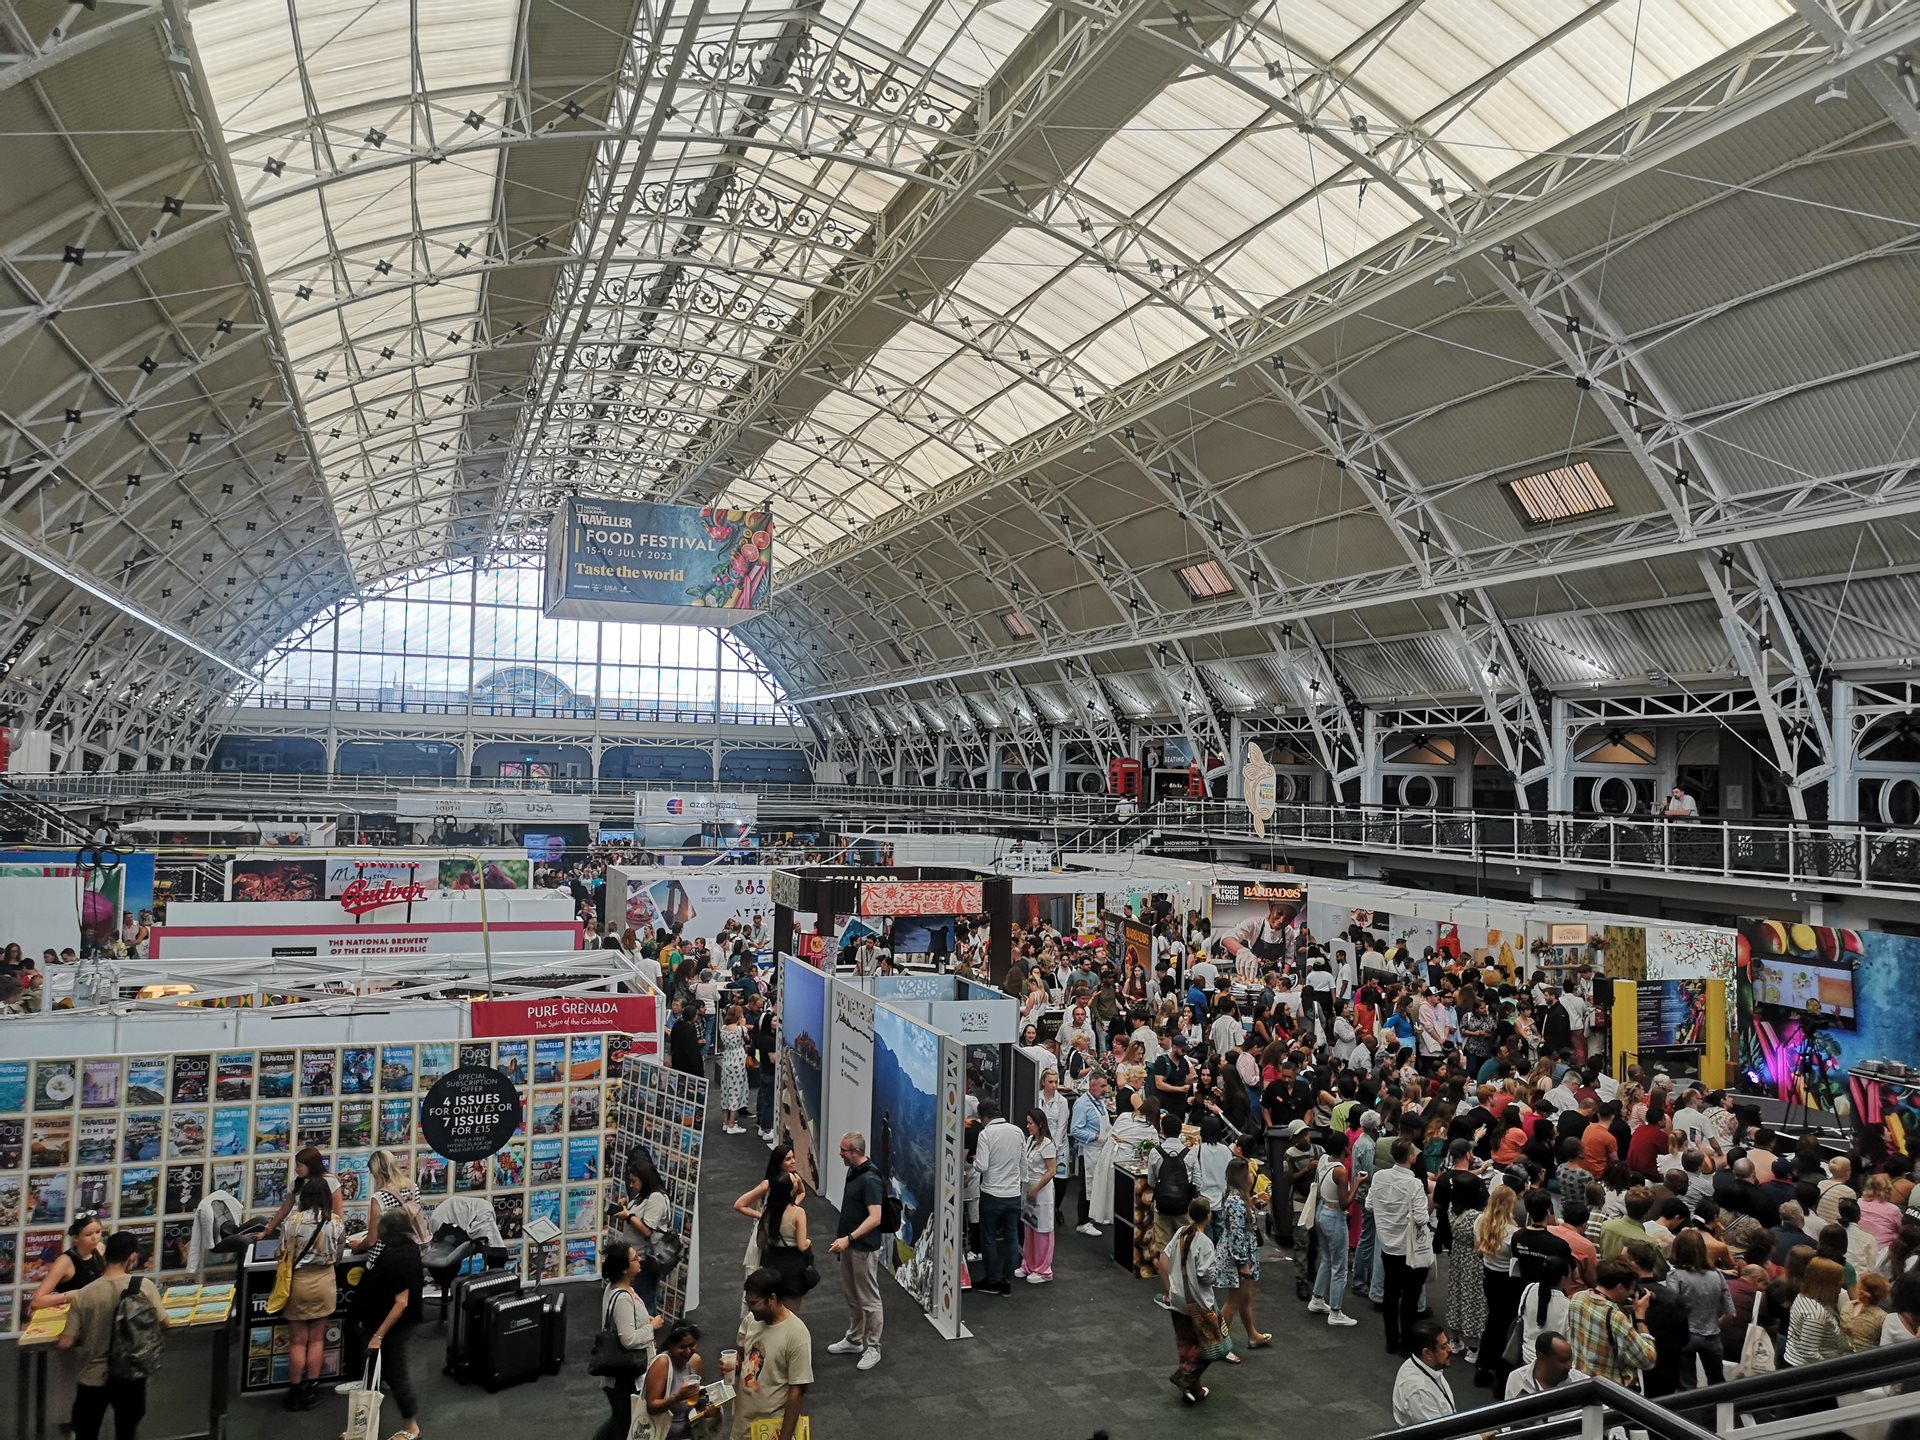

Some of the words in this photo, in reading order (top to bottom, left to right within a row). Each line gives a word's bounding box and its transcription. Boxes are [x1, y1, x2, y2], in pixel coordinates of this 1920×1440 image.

[576, 514, 632, 528] TRAVELLER
[586, 530, 634, 546] FOOD
[640, 534, 716, 552] FESTIVAL
[586, 546, 614, 556] 15-16
[617, 549, 644, 558] JULY
[648, 551, 673, 560] 2023
[574, 562, 614, 578] Taste
[617, 565, 640, 580] the
[642, 569, 684, 582] world
[526, 803, 554, 812] USA
[896, 979, 938, 990] MONTE
[528, 1004, 558, 1018] PURE
[562, 1002, 618, 1014] GRENADA
[548, 1020, 563, 1028] Spice
[581, 1017, 613, 1026] Caribbean
[460, 1049, 490, 1058] FOOD
[174, 1061, 209, 1072] FOOD
[446, 1079, 498, 1088] SUBSCRIPTION
[443, 1097, 451, 1106] 4
[456, 1094, 500, 1105] ISSUES
[430, 1108, 449, 1116] FOR
[453, 1106, 480, 1115] ONLY
[484, 1104, 495, 1112] £3
[498, 1103, 512, 1111] OR
[443, 1118, 450, 1127] 7
[455, 1114, 499, 1126] ISSUES
[452, 1127, 471, 1135] FOR
[475, 1125, 490, 1133] £15
[494, 1200, 522, 1209] FOOD
[165, 1227, 192, 1237] FOO
[567, 1241, 595, 1250] TRAVELLER
